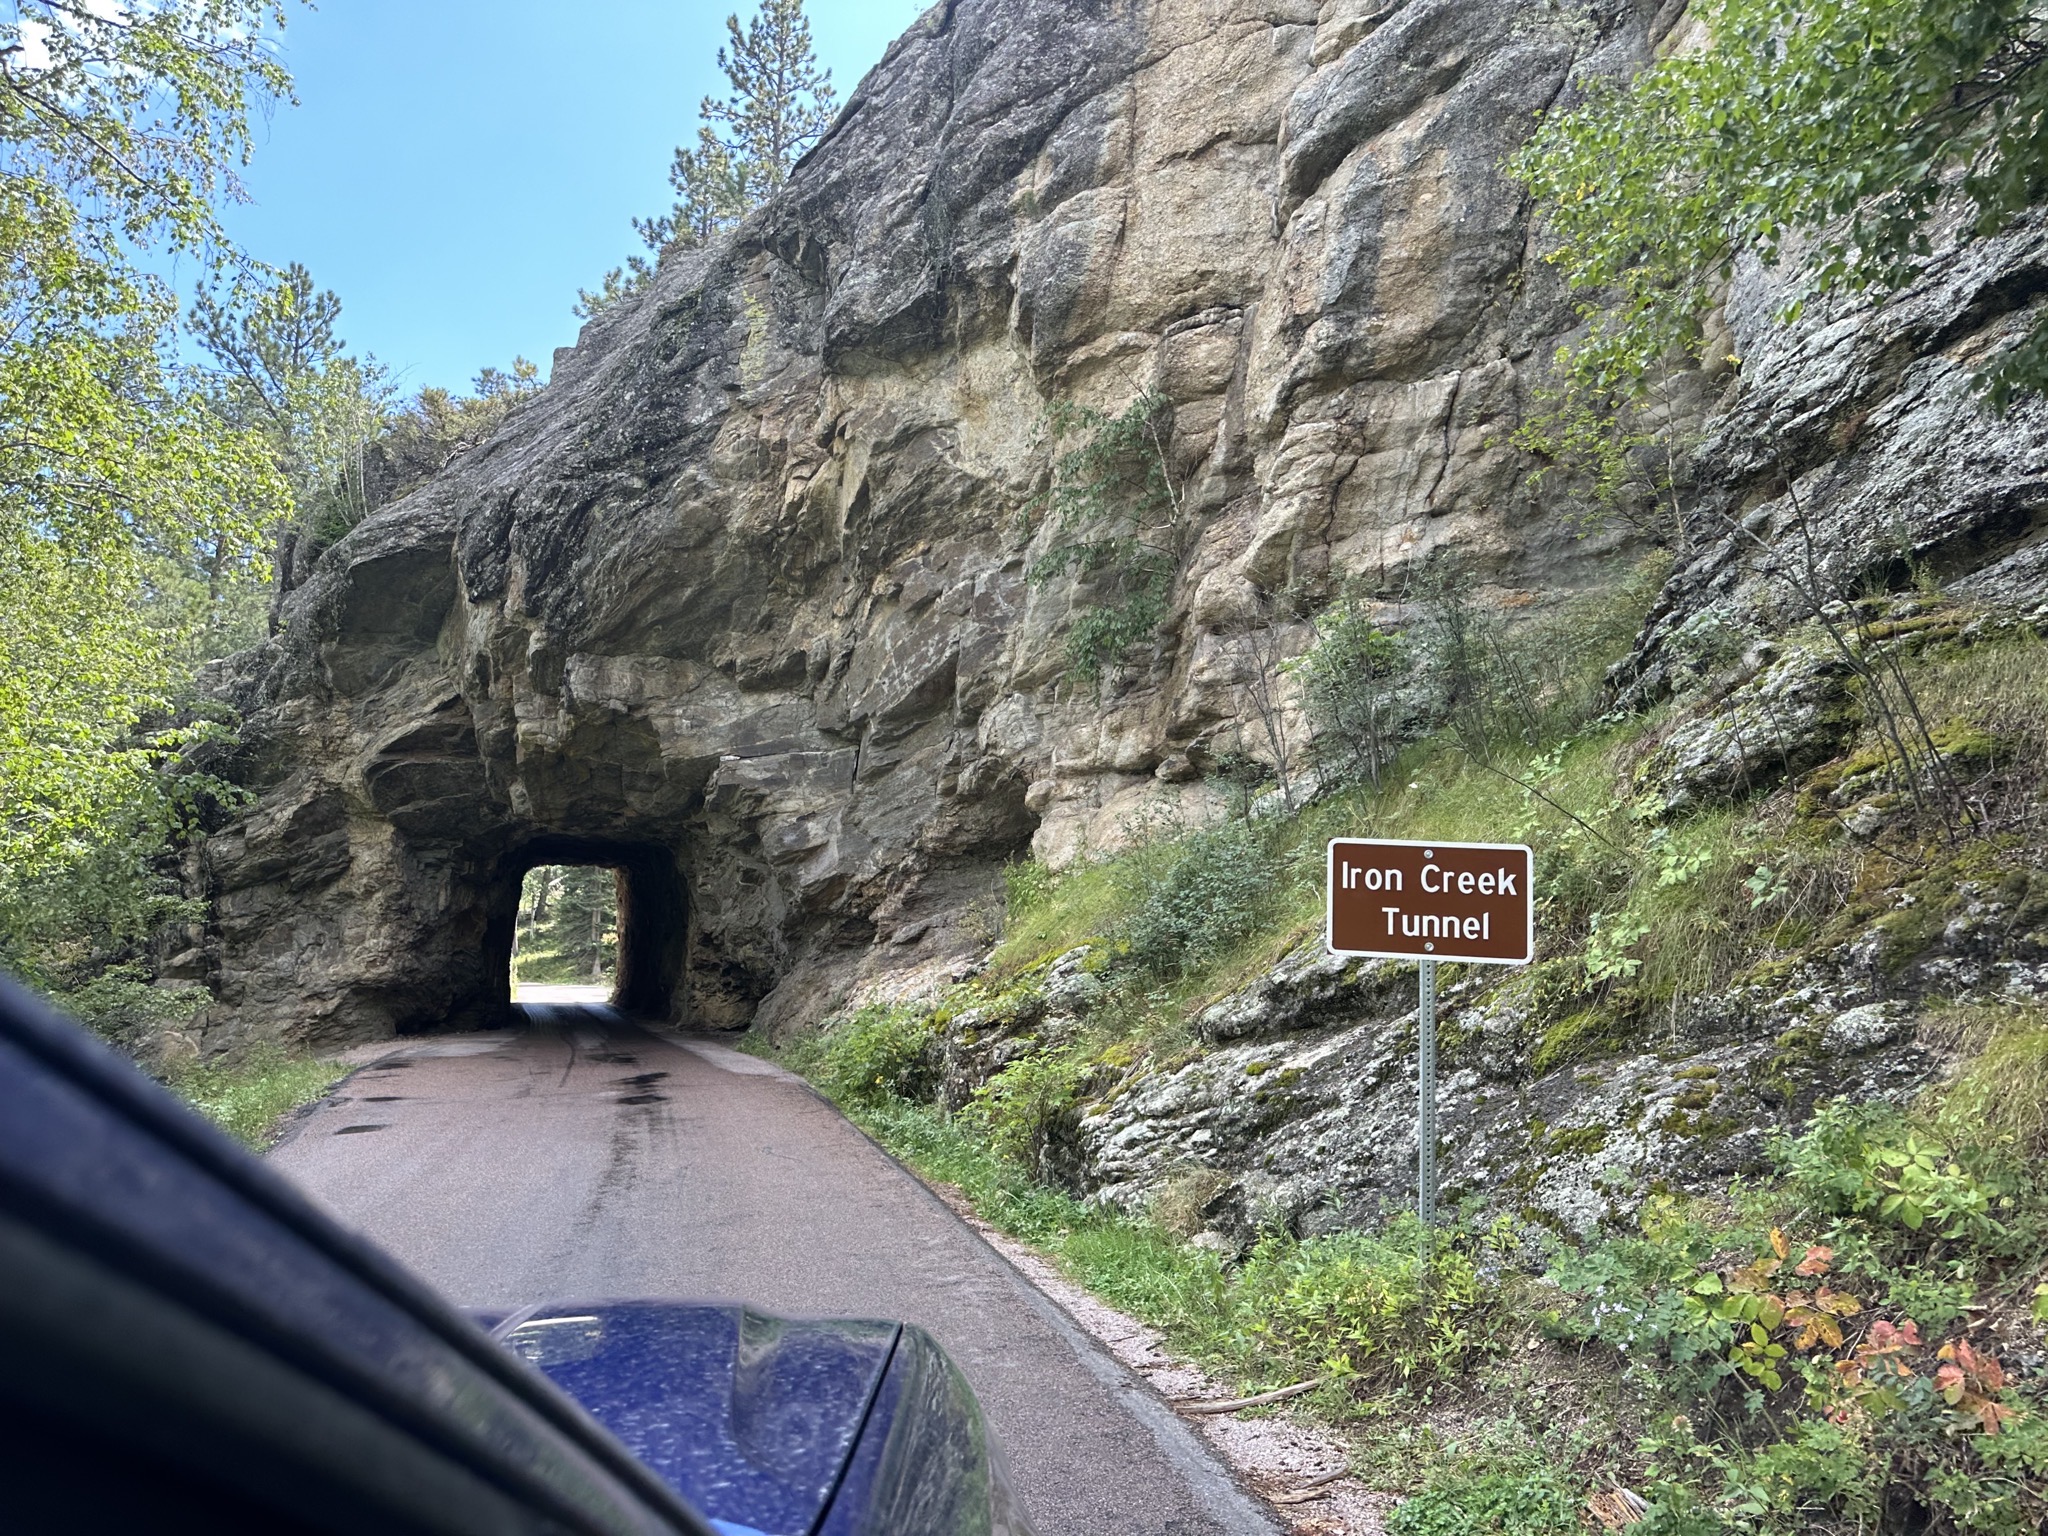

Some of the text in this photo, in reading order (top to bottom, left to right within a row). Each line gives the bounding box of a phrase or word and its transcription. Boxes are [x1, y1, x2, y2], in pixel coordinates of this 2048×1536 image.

[1342, 861, 1517, 896] Iron Creek
[1381, 906, 1489, 940] Tunnel
